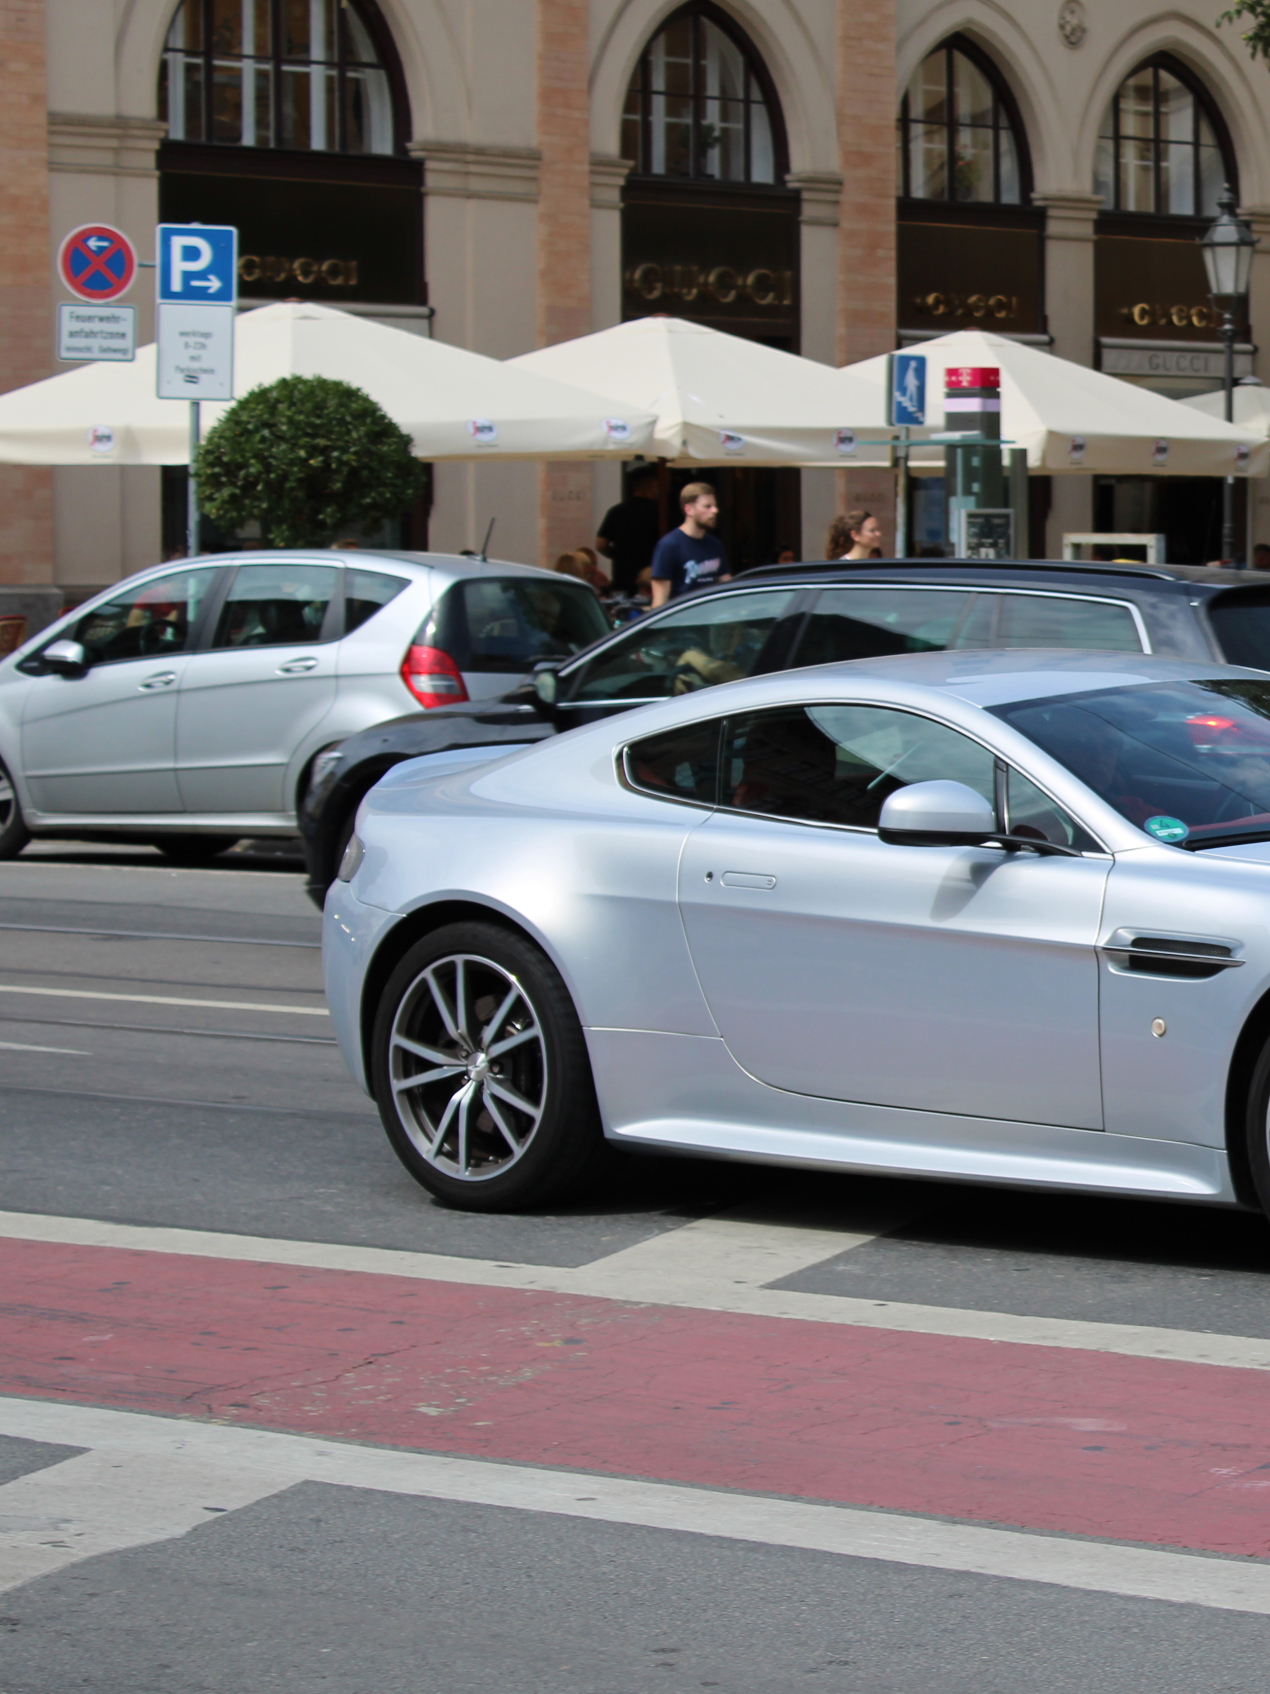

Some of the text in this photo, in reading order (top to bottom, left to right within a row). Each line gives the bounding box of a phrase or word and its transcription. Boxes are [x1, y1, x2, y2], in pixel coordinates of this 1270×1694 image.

[171, 235, 213, 292] P
[632, 263, 792, 305] GUCCI
[69, 311, 127, 324] Feuerwehr-
[67, 327, 127, 340] anfahrtzone
[1147, 354, 1210, 373] GUCCI
